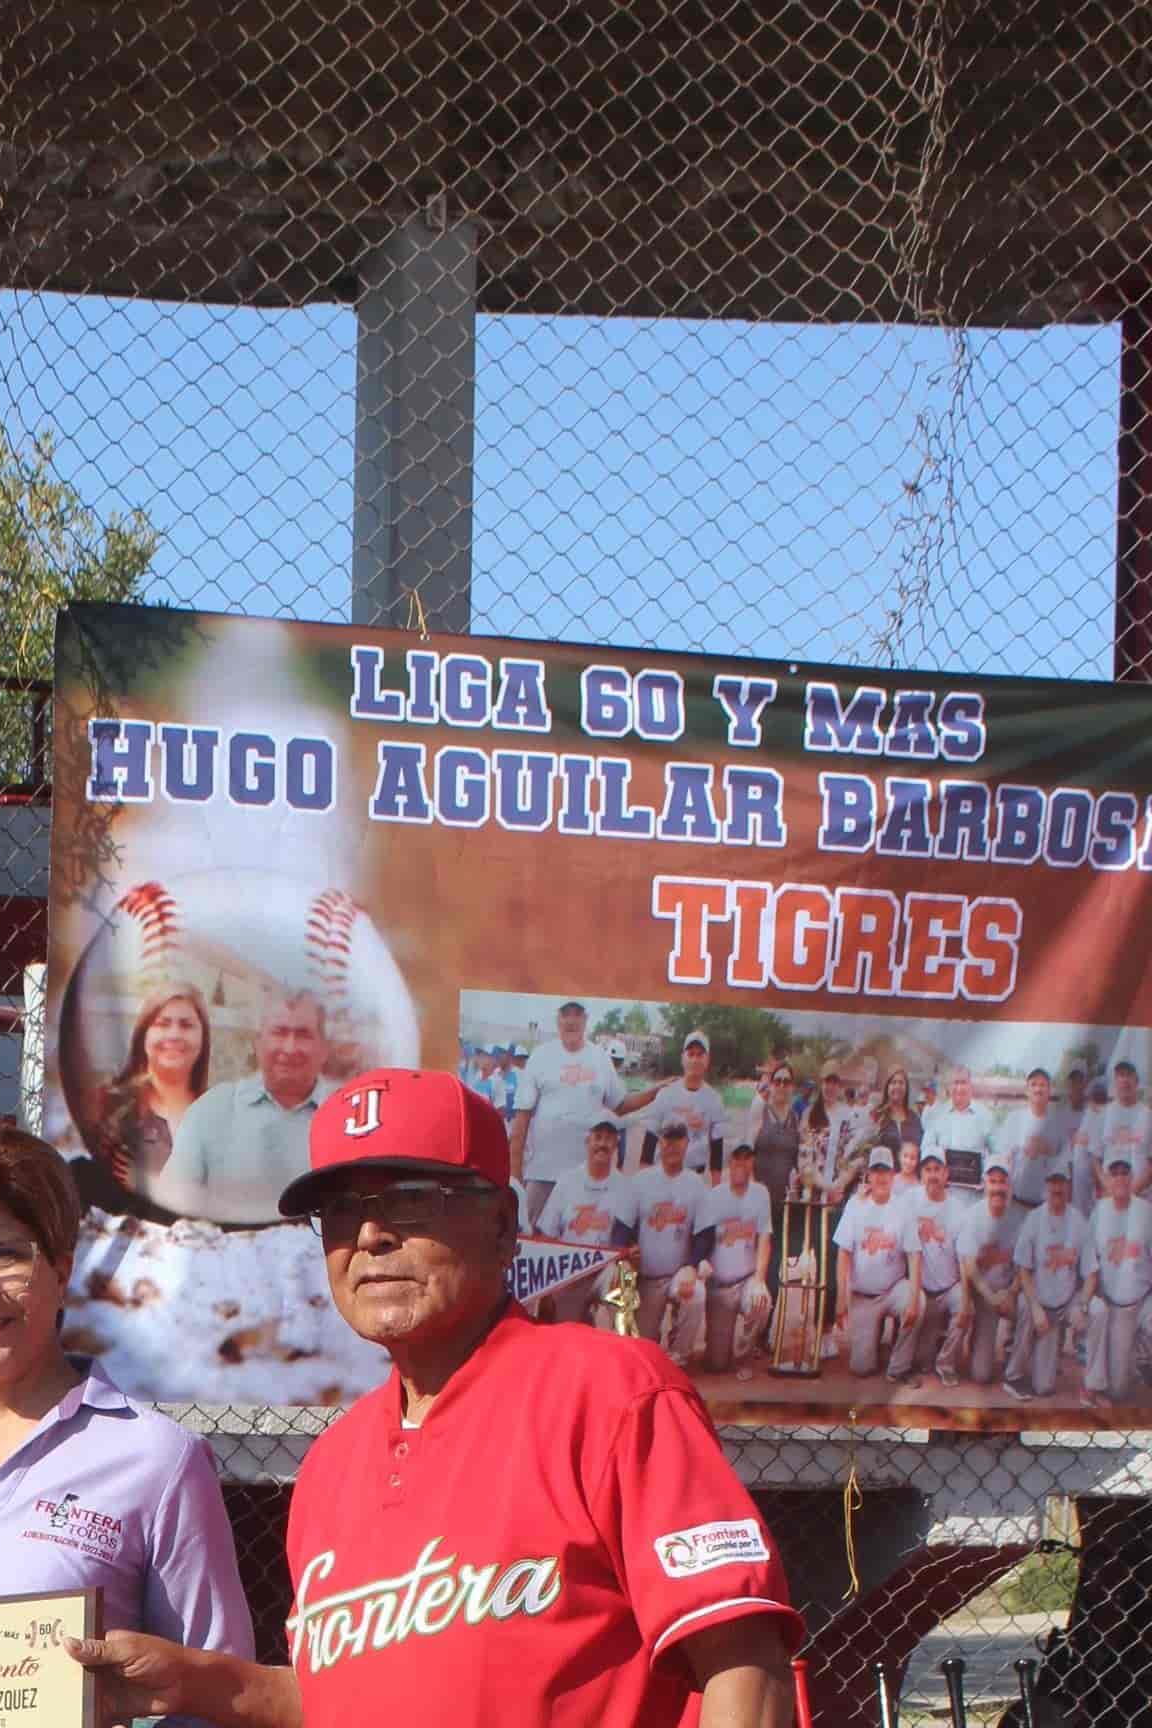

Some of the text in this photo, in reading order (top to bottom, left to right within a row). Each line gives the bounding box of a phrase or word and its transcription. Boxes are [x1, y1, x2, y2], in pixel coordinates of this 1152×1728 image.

[350, 645, 987, 763] LIGA 60 Y MAS
[86, 718, 338, 815] HUGO
[368, 740, 788, 848] AGUILAR
[652, 874, 1024, 1003] TIGRES
[692, 1528, 750, 1546] Frontera
[39, 1623, 52, 1636] 60
